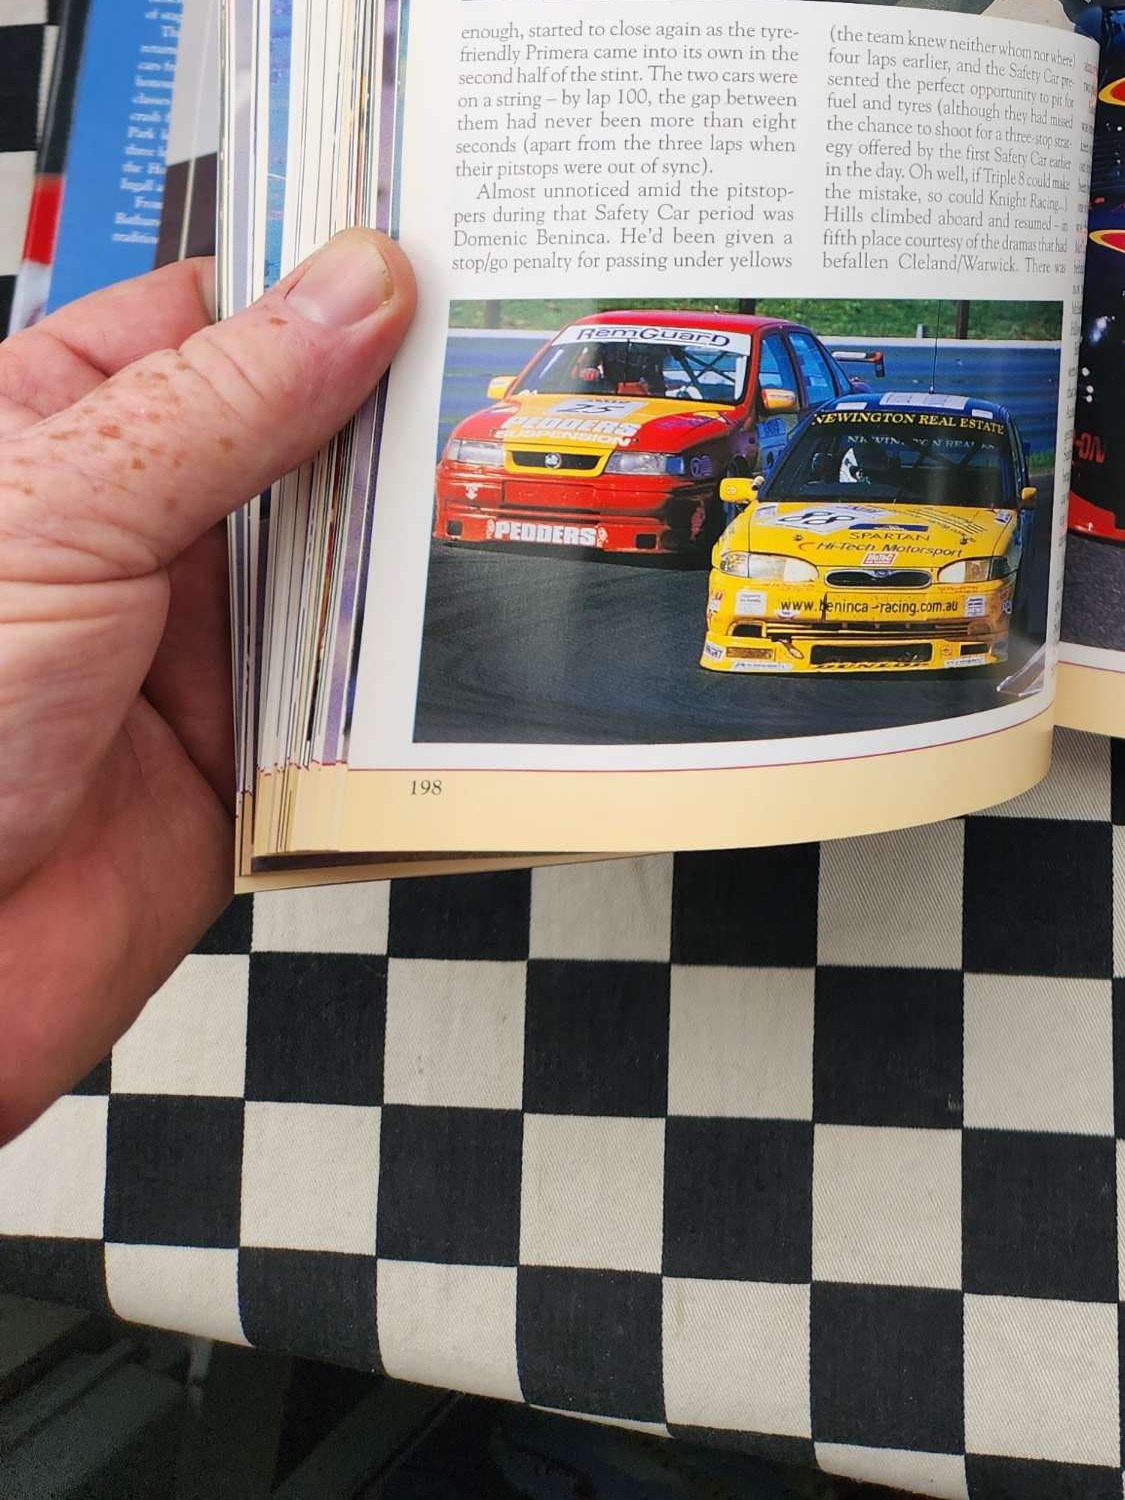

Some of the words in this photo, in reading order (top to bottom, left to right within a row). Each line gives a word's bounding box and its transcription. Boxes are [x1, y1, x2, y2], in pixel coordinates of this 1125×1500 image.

[461, 21, 524, 42] enough,
[528, 20, 583, 38] started
[588, 24, 606, 36] to
[609, 19, 652, 36] close
[656, 22, 702, 40] again
[706, 26, 723, 37] as
[728, 20, 756, 38] the
[761, 26, 800, 42] tyre-
[830, 24, 864, 44] (the
[867, 31, 905, 45] team
[907, 29, 947, 48] knew
[949, 36, 997, 54] neither
[998, 40, 1032, 60] whom
[460, 44, 521, 65] friendly
[526, 44, 589, 60] Primera
[593, 48, 638, 59] came
[643, 44, 678, 59] into
[683, 44, 702, 60] its
[707, 48, 744, 60] own
[749, 45, 766, 61] in
[772, 44, 799, 62] the
[828, 46, 861, 64] four
[867, 48, 897, 70] laps
[902, 52, 951, 74] earlier,
[956, 58, 981, 74] and
[985, 59, 1006, 77] the
[1009, 62, 1041, 84] Safety
[458, 66, 513, 85] second
[517, 66, 550, 84] half
[550, 66, 570, 83] of
[570, 65, 597, 82] the
[600, 67, 643, 82] stint.
[647, 64, 683, 82] The
[687, 69, 719, 82] two
[722, 71, 755, 83] cars
[758, 72, 798, 84] were
[458, 97, 478, 108] on
[483, 96, 492, 108] a
[496, 92, 542, 110] string
[562, 88, 581, 109] by
[586, 88, 611, 109] lap
[618, 88, 652, 107] 100,
[658, 87, 686, 104] the
[690, 94, 721, 109] gap
[726, 88, 797, 107] between
[457, 114, 498, 131] them
[506, 112, 537, 130] had
[545, 117, 593, 129] never
[600, 110, 642, 128] been
[650, 116, 695, 128] more
[704, 110, 743, 128] than
[752, 112, 797, 133] eight
[456, 135, 516, 154] seconds
[523, 135, 572, 156] (apart
[577, 134, 616, 151] from
[624, 133, 652, 151] the
[658, 133, 703, 151] three
[710, 133, 743, 156] laps
[749, 134, 796, 152] when
[456, 159, 494, 177] their
[497, 161, 559, 180] pitstops
[564, 163, 602, 174] were
[607, 162, 636, 174] out
[640, 156, 660, 174] of
[662, 156, 713, 178] sync).
[476, 182, 536, 200] Almost
[544, 180, 630, 198] unnoticed
[638, 180, 681, 197] amid
[690, 180, 719, 198] the
[726, 182, 794, 202] pitstop-
[501, 415, 642, 436] PEDDERS
[812, 411, 916, 426] NEWINGTON
[919, 414, 957, 428] REAL
[959, 418, 1005, 435] ESTATE
[494, 429, 633, 447] SUSPENSION
[494, 520, 597, 546] PEDDERS
[849, 531, 931, 542] SPARTAN
[882, 543, 963, 558] Motorsport
[408, 779, 443, 797] 198
